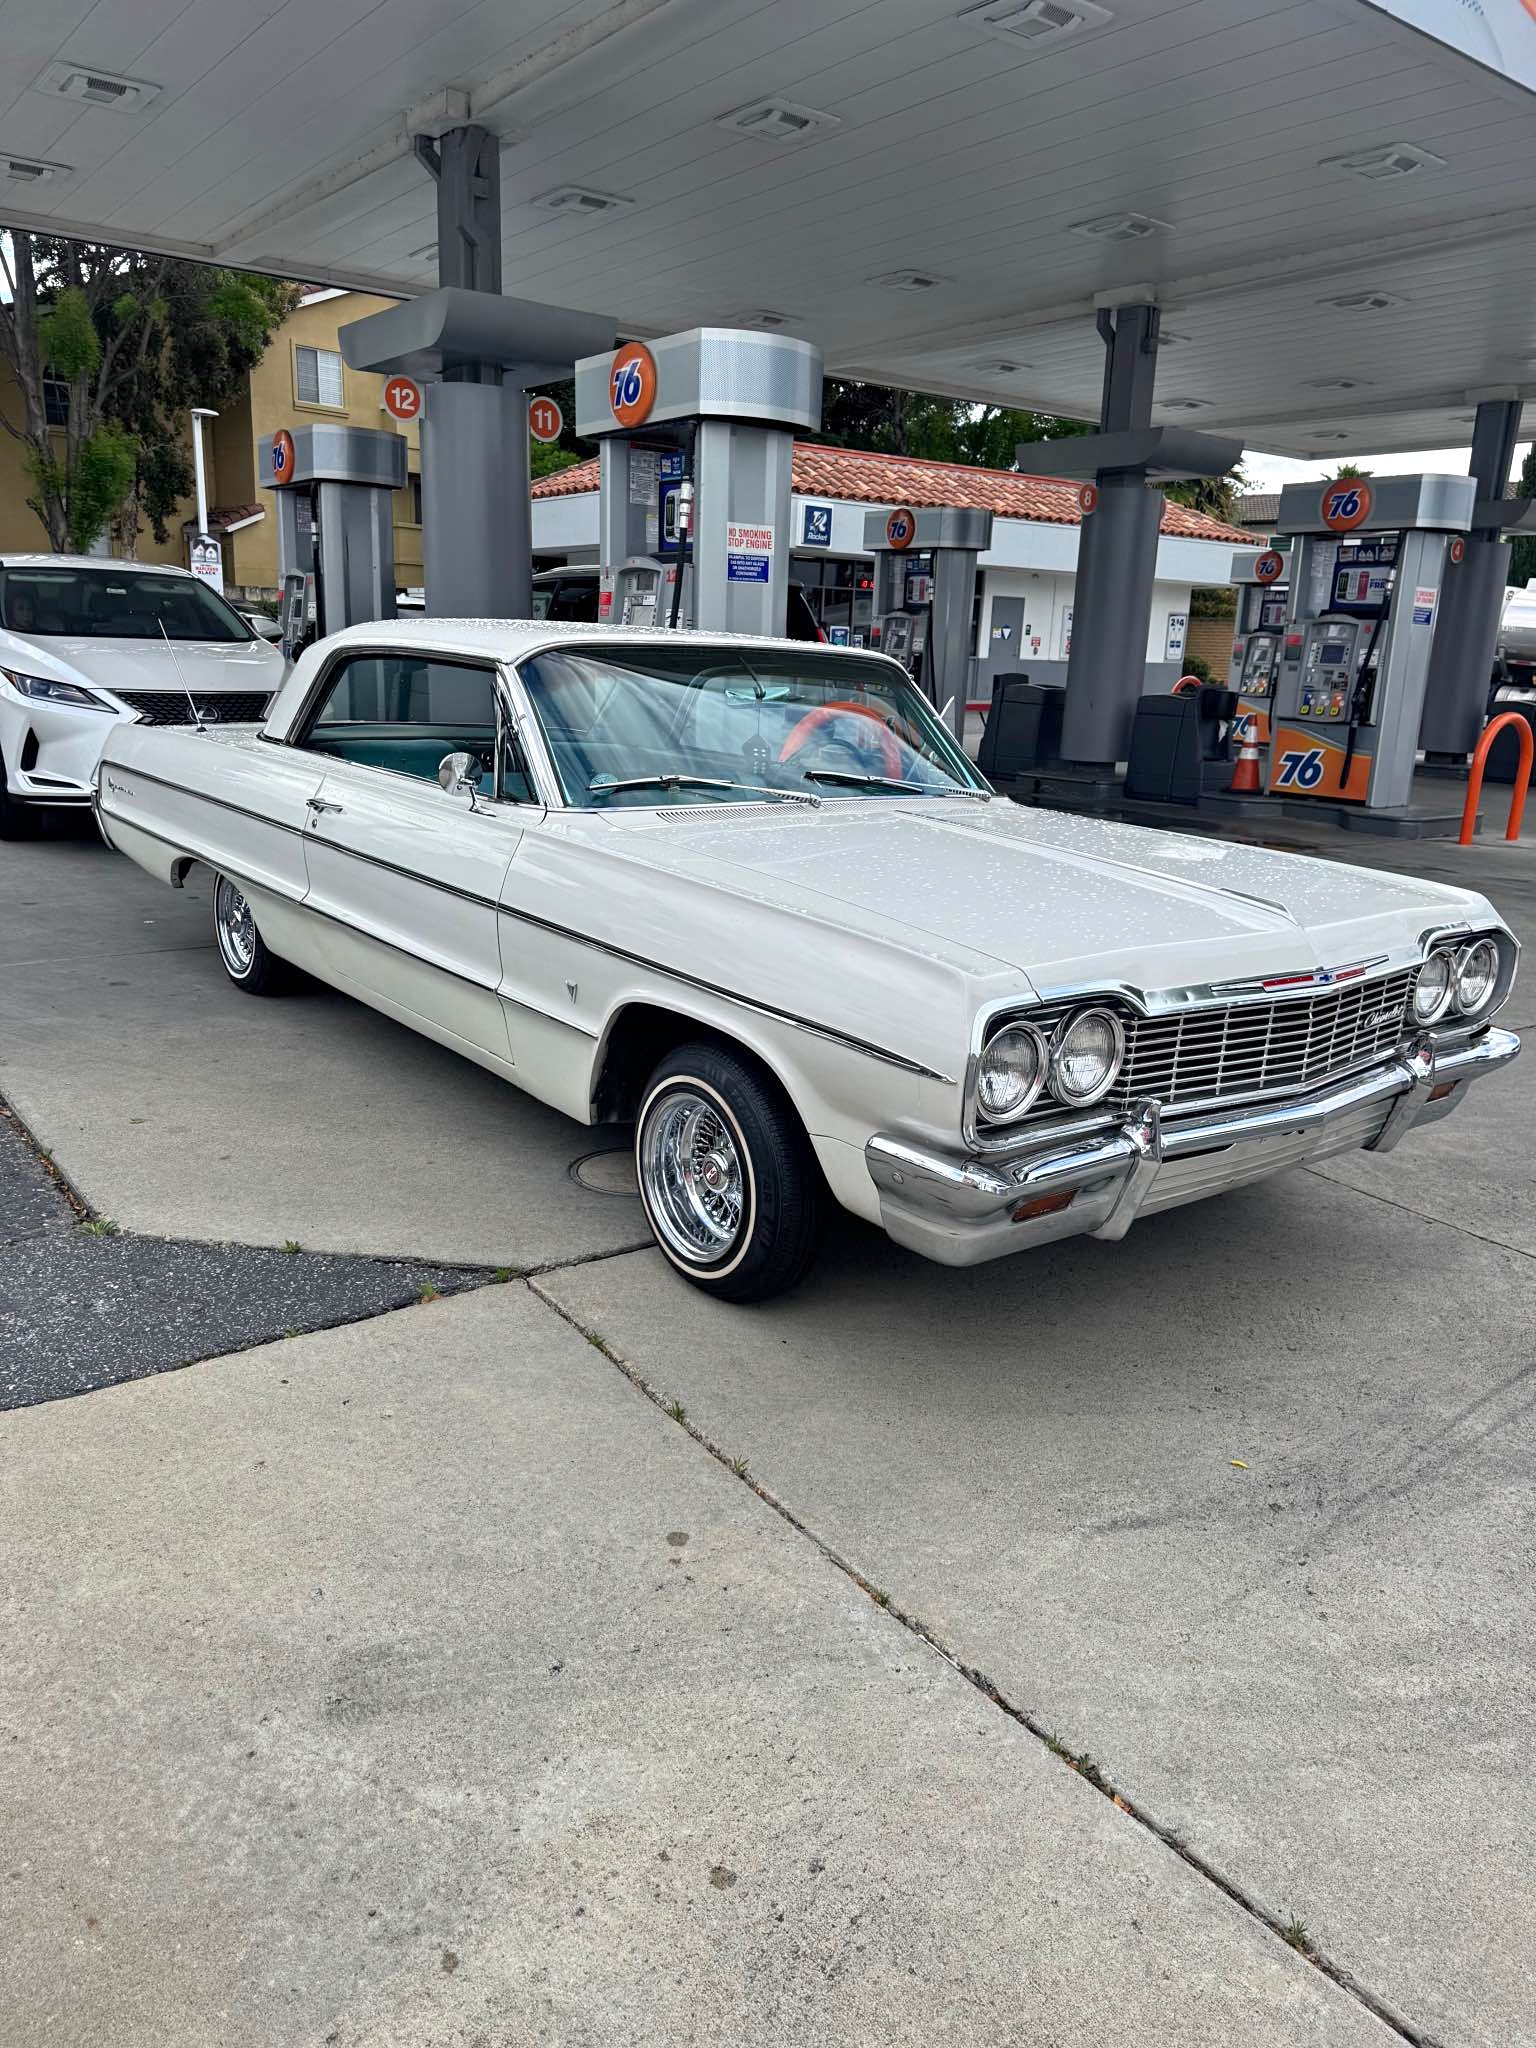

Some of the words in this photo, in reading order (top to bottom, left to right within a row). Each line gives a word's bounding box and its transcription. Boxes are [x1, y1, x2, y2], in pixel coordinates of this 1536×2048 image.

[612, 359, 643, 410] 76
[391, 387, 415, 411] 12
[535, 408, 552, 431] 11
[272, 441, 286, 472] 76
[1084, 490, 1092, 506] 8
[1328, 488, 1362, 519] 76
[728, 528, 737, 537] NO
[739, 529, 772, 540] SMOKING
[807, 532, 828, 541] Rocket
[889, 517, 908, 541] 76
[728, 537, 744, 547] STOP
[746, 539, 772, 549] ENGINE
[1454, 544, 1460, 557] 4
[1259, 559, 1276, 576] 76
[1276, 748, 1327, 789] 76
[1363, 1004, 1404, 1029] Chevrolet
